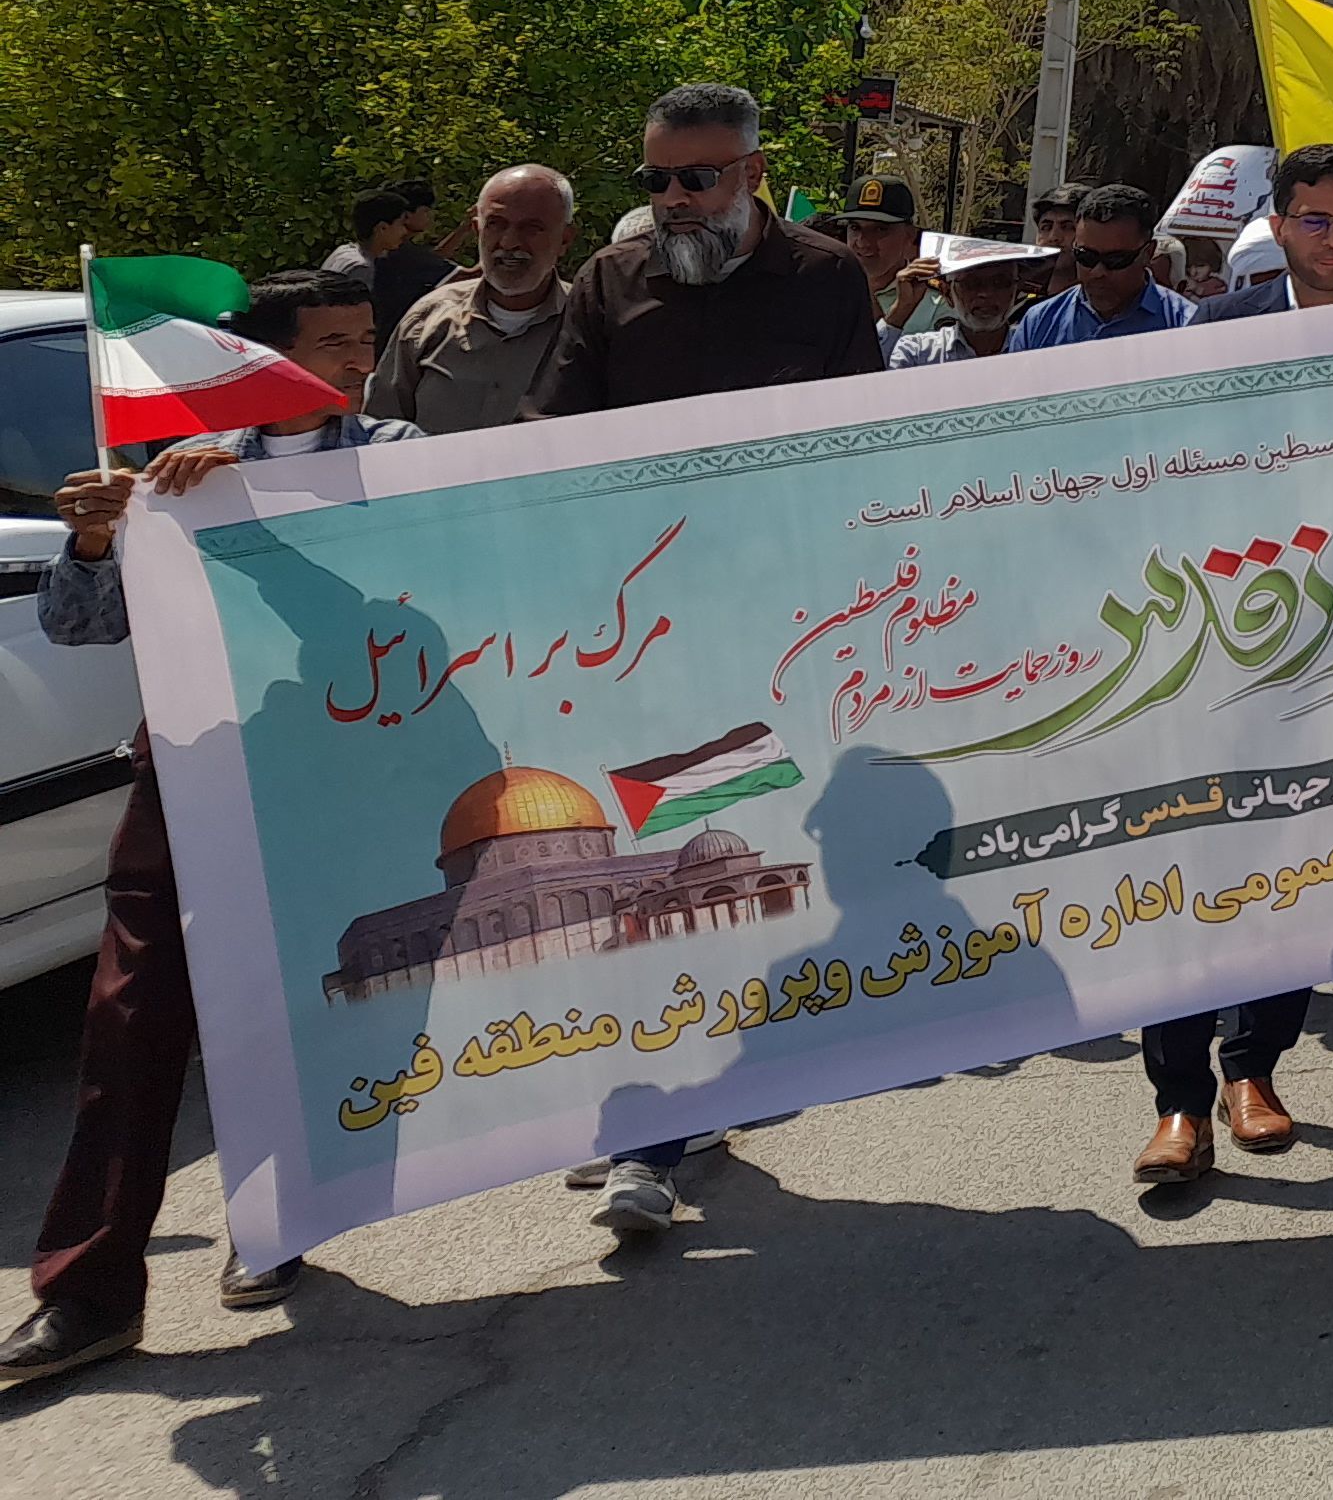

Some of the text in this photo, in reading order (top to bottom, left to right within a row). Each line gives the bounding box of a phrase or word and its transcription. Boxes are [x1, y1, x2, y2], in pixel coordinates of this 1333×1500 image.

[939, 473, 1022, 522] اسلام
[1028, 470, 1105, 506] جهان
[1110, 454, 1157, 492] اول
[1164, 447, 1247, 479] مسئله
[576, 516, 686, 682] مرگ
[771, 544, 920, 705] فلسطین
[882, 575, 978, 671] مظلوم
[529, 630, 568, 715] بر
[831, 642, 1103, 744] روز حمایت از مردم
[869, 537, 1300, 764] قدس
[1021, 800, 1123, 860] گرامی
[1125, 776, 1225, 836] قدس
[1225, 773, 1330, 819] جهانی
[861, 888, 1050, 997] آموزش
[1060, 865, 1185, 950] اداره
[338, 1029, 443, 1131] فین
[453, 1007, 621, 1077] منطقه
